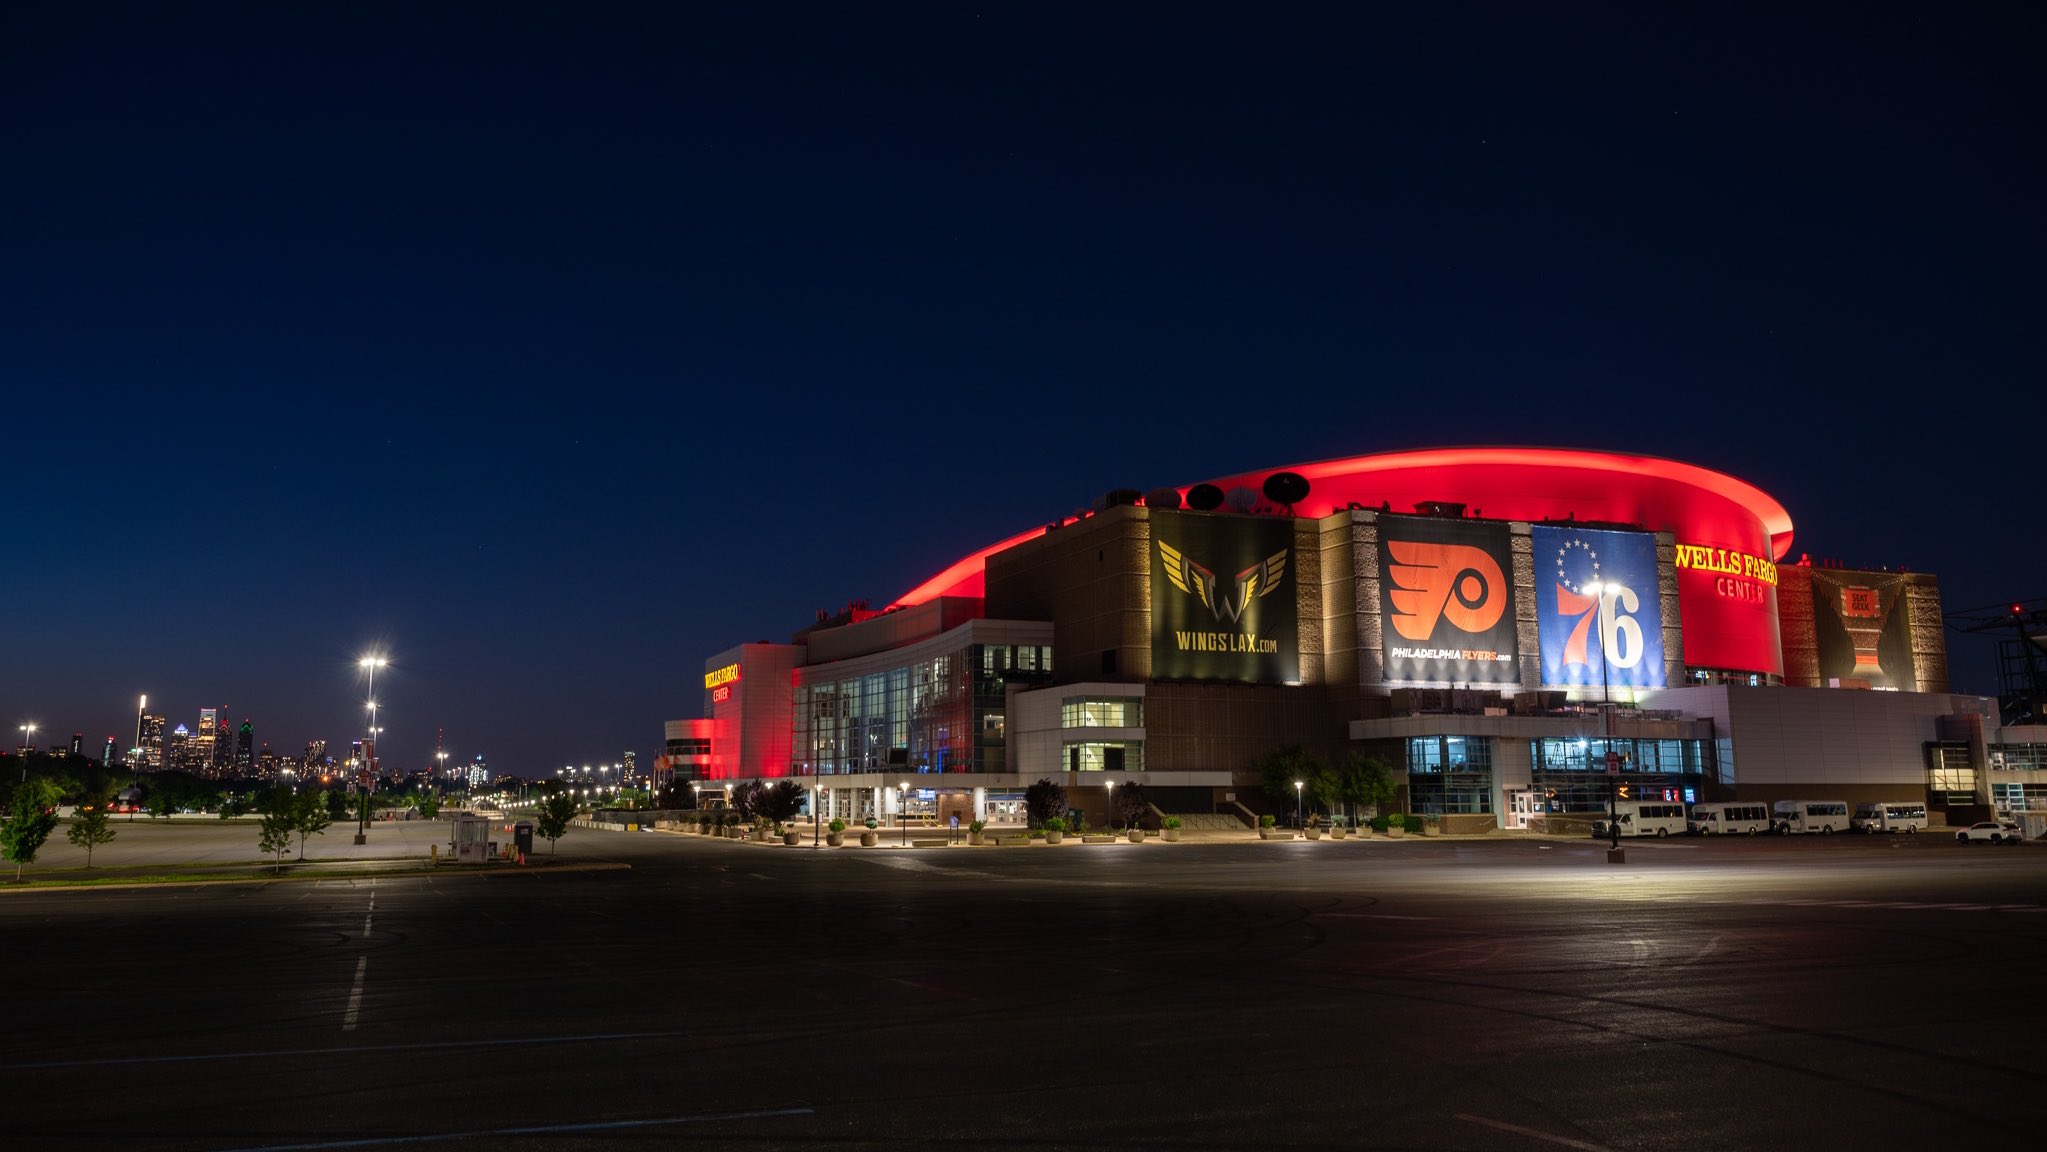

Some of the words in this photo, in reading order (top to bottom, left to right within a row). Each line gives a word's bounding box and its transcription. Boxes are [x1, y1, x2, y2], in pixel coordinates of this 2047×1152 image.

[1675, 544, 1742, 575] WELLS
[1743, 554, 1778, 586] FARGO
[1717, 578, 1764, 604] CENTER
[1852, 593, 1868, 602] SEAT
[1852, 602, 1871, 611] GEEK
[1556, 582, 1644, 668] 76
[713, 686, 728, 702] CENTER
